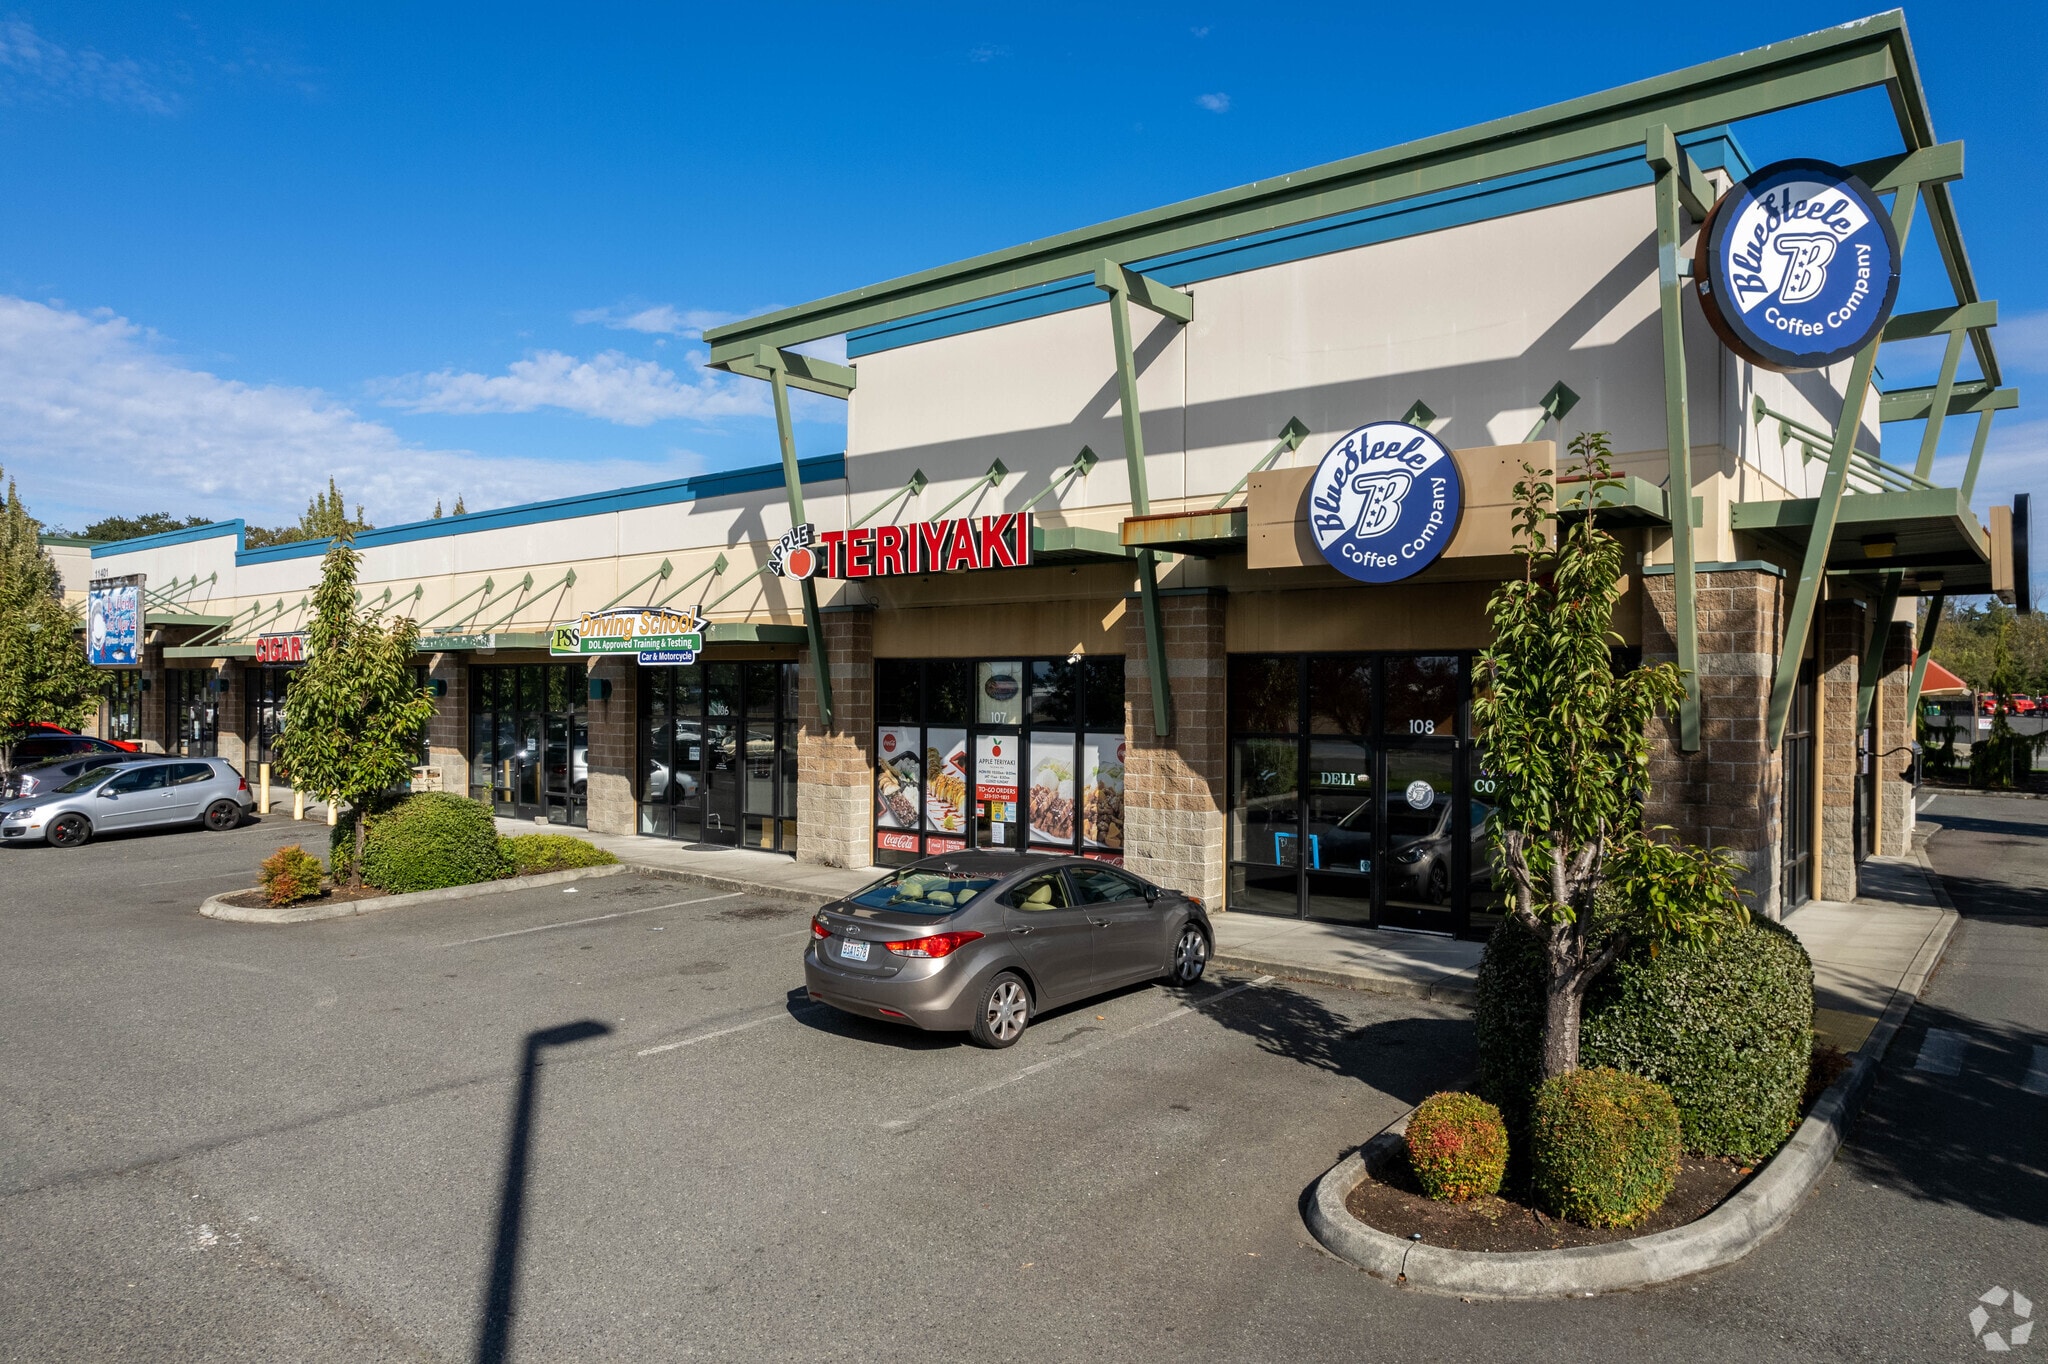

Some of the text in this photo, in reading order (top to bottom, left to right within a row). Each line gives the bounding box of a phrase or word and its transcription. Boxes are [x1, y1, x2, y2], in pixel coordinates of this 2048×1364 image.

[1765, 243, 1871, 336] Coffee Company
[1342, 477, 1446, 567] Coffee Company
[767, 523, 809, 576] APPLE
[820, 512, 1031, 579] TERIYAKI
[95, 567, 108, 578] 11401
[579, 607, 696, 641] Driving School
[556, 628, 580, 647] PSS
[588, 637, 692, 650] DOL Approved Training & Testing
[256, 636, 302, 662] CIGAR
[641, 651, 692, 662] Car & Motorcycle
[717, 705, 729, 716] 106
[991, 711, 1007, 723] 107
[1409, 719, 1435, 734] 108
[1320, 772, 1356, 786] DELI
